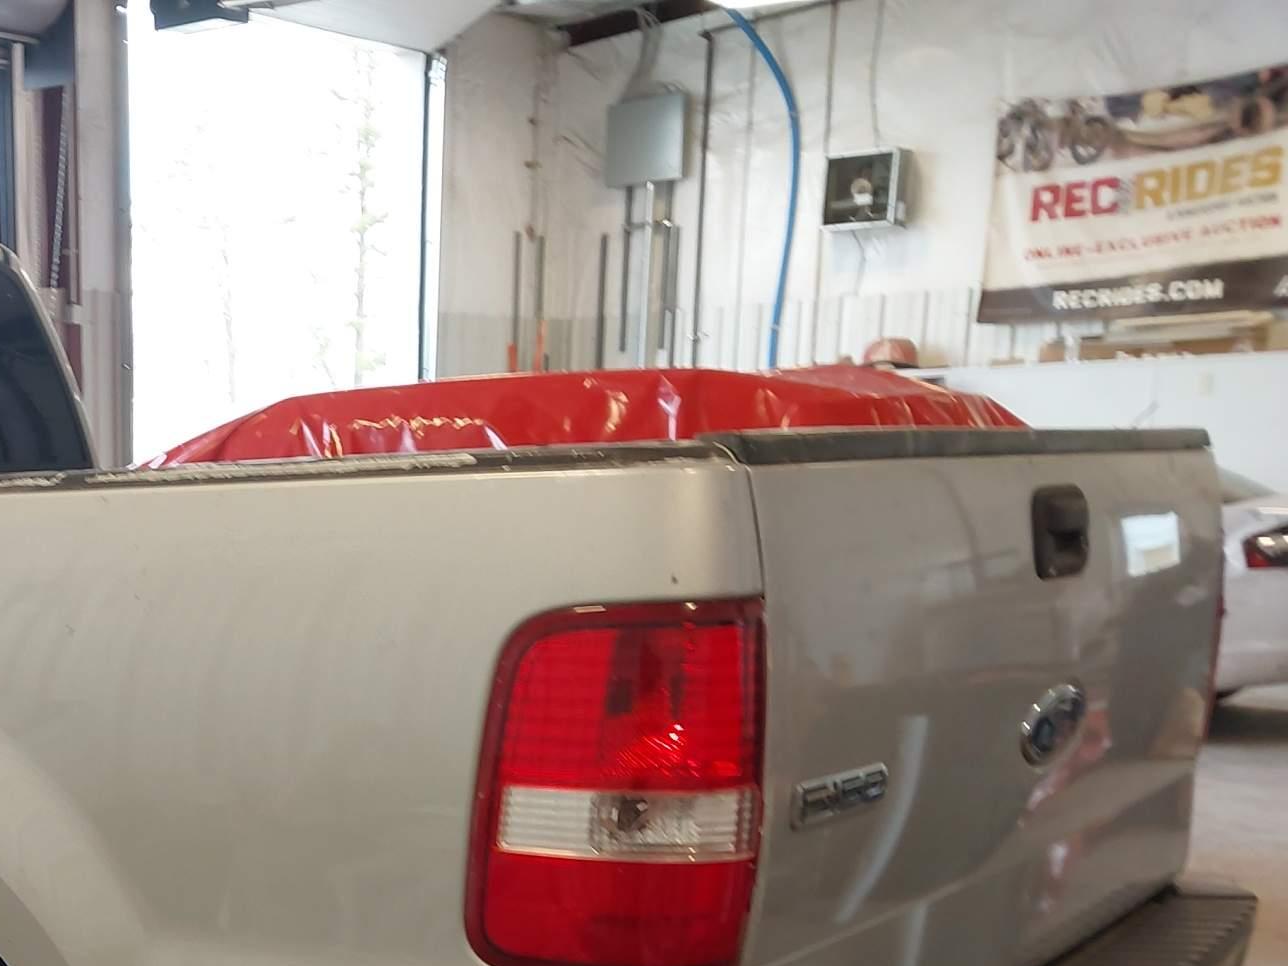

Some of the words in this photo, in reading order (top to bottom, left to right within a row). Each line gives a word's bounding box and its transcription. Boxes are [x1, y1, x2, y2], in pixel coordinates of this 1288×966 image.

[1031, 177, 1120, 222] REC
[1136, 146, 1284, 209] RIDES
[1052, 279, 1224, 310] RECRIDES.COM
